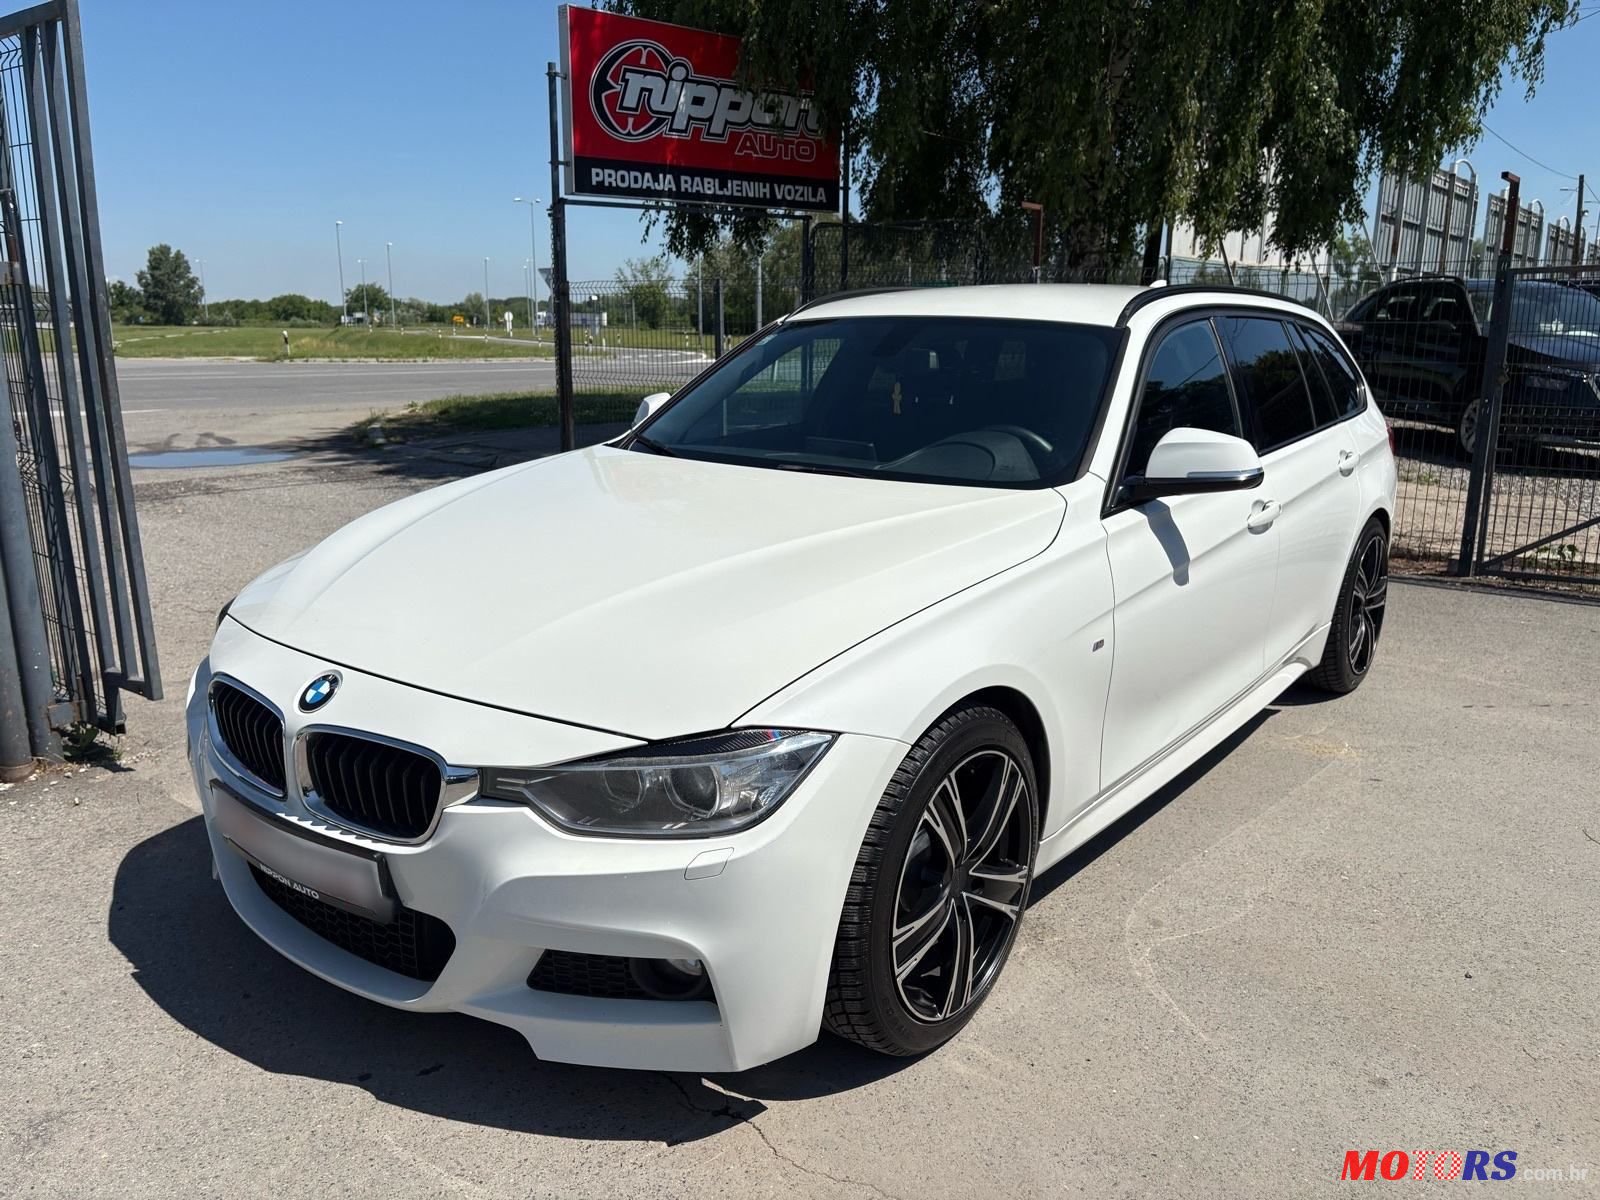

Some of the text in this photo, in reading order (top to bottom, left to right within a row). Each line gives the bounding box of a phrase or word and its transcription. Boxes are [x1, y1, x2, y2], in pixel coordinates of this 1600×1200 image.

[735, 133, 816, 162] AUTO
[591, 167, 827, 203] PRODAJA RABLJENIH VOZILA
[293, 882, 319, 899] AUTO
